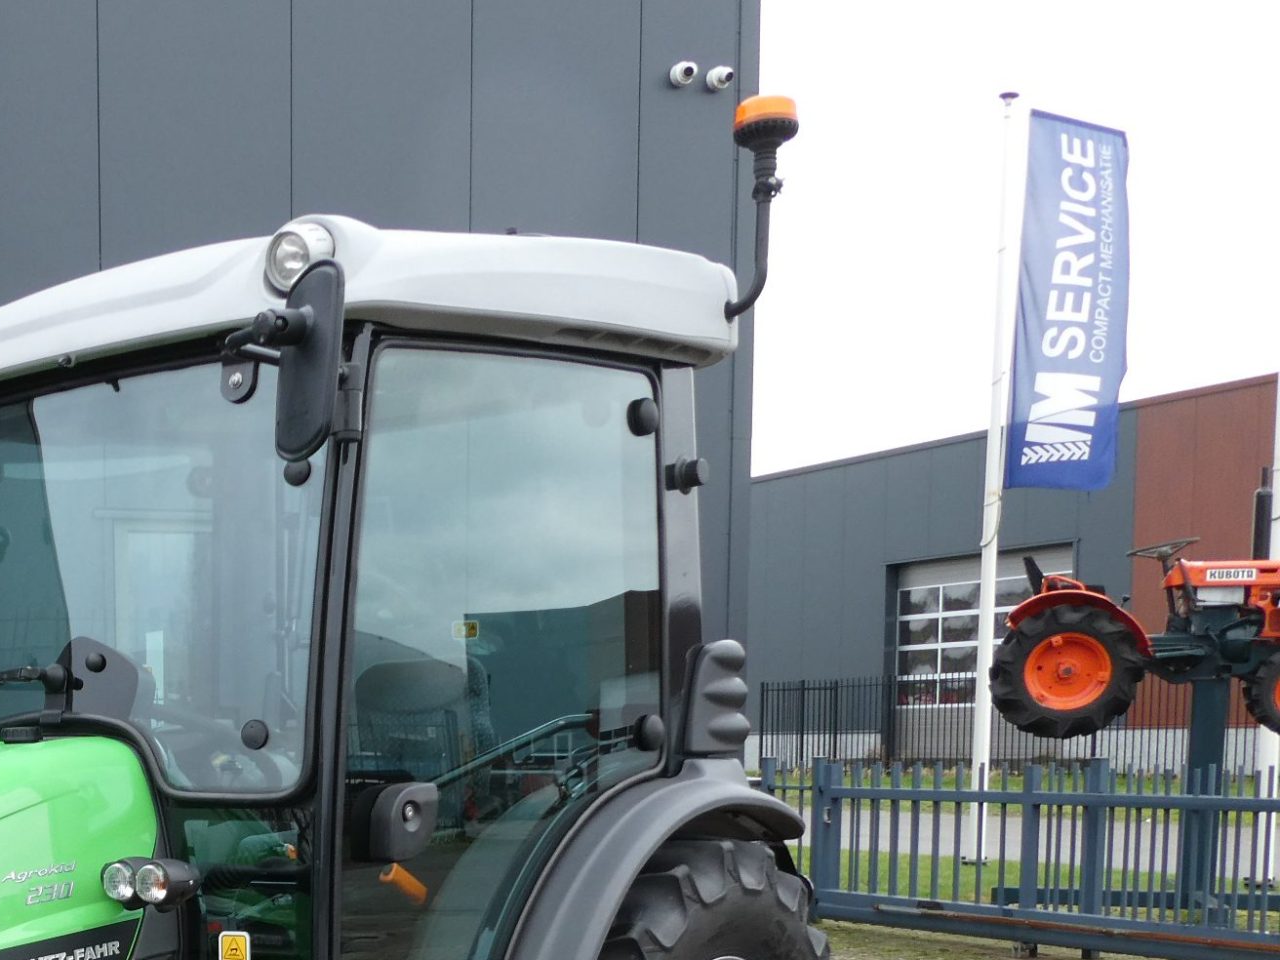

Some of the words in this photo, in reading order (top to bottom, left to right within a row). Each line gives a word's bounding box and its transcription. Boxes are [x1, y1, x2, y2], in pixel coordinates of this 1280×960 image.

[1041, 133, 1097, 360] SERVICE
[1099, 143, 1114, 270] MECHANISATIE
[1089, 272, 1112, 363] COMPACT
[1209, 570, 1253, 579] KUBOTA
[25, 880, 74, 906] 230
